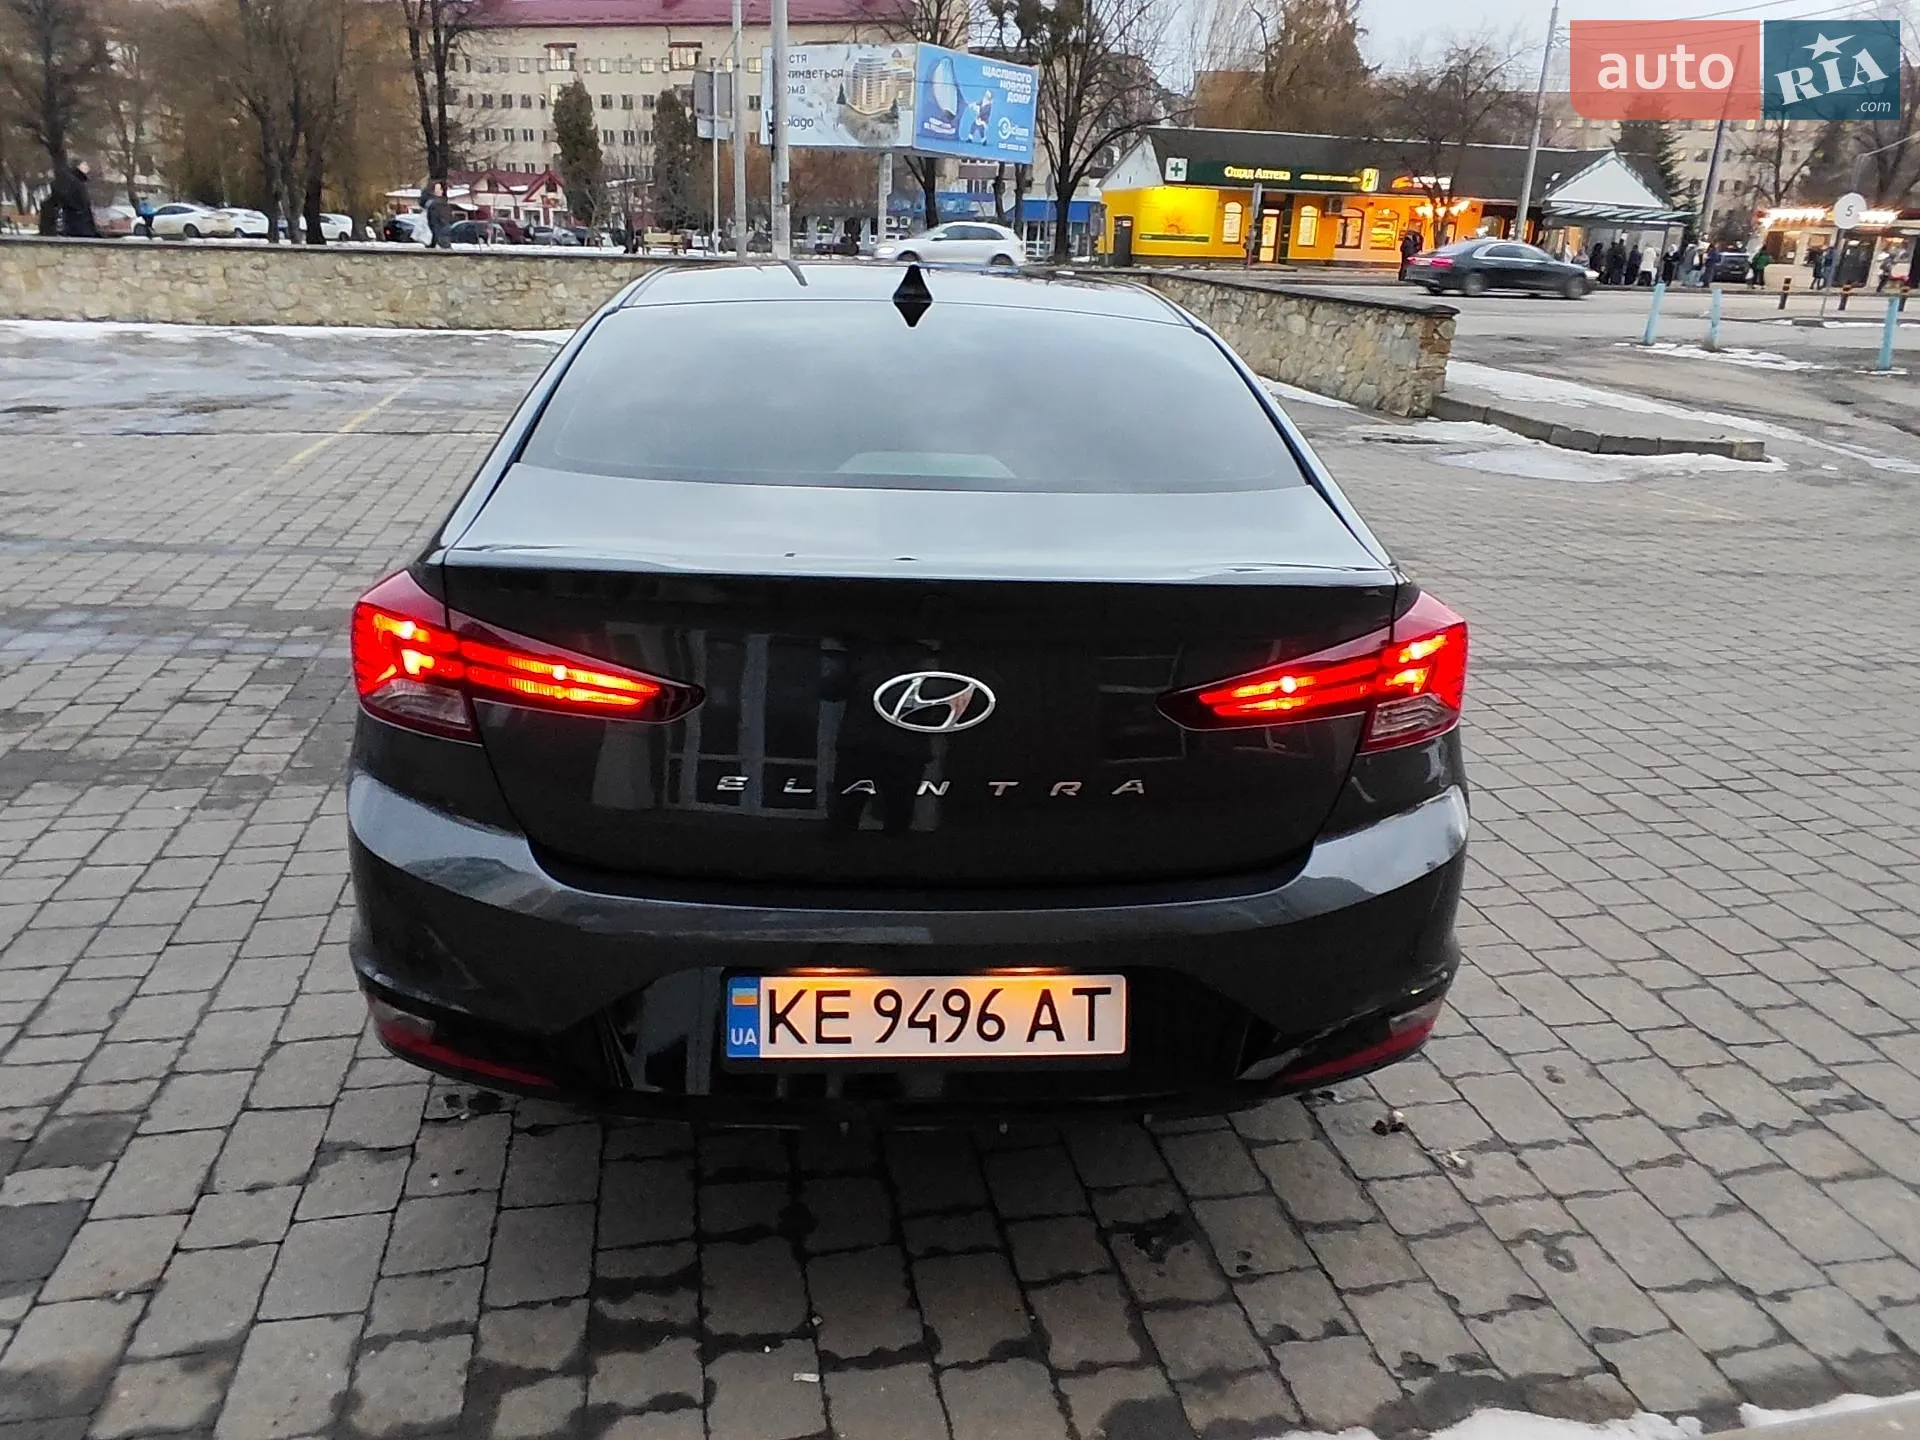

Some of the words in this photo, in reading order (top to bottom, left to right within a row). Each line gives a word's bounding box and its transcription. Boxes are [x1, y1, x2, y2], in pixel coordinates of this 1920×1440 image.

[788, 54, 808, 64] стя
[716, 775, 1146, 797] ELANTRA
[767, 988, 852, 1045] KE
[873, 987, 1006, 1044] 9496
[1025, 987, 1112, 1043] AT
[730, 1028, 758, 1046] UA
